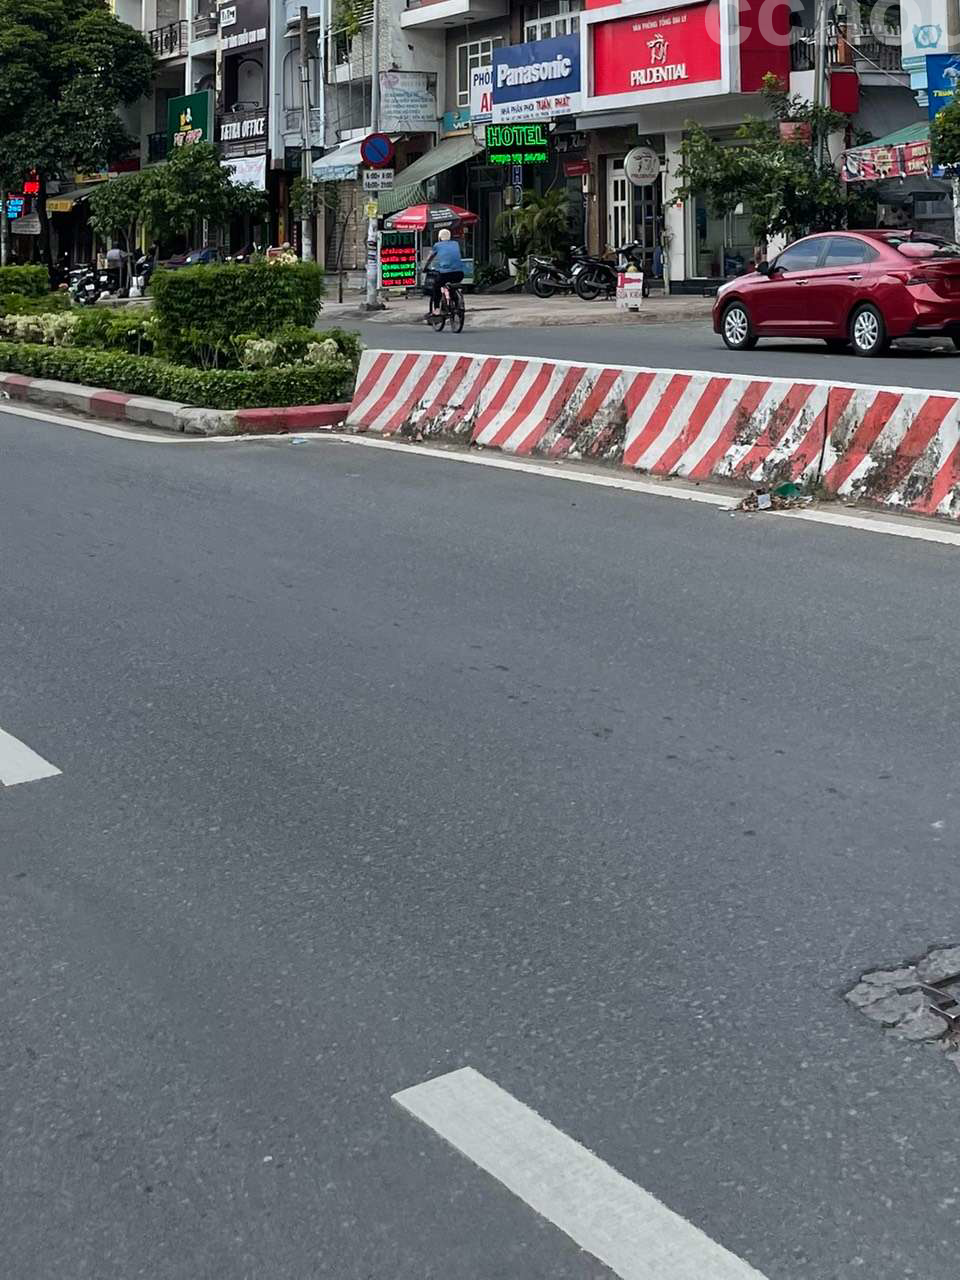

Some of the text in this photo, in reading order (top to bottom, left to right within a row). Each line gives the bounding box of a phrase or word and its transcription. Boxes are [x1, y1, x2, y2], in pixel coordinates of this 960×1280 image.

[497, 54, 572, 88] Panasonic
[630, 62, 689, 87] PRUDENTIAL
[241, 118, 265, 138] OFFICE
[487, 125, 548, 147] HOTEL
